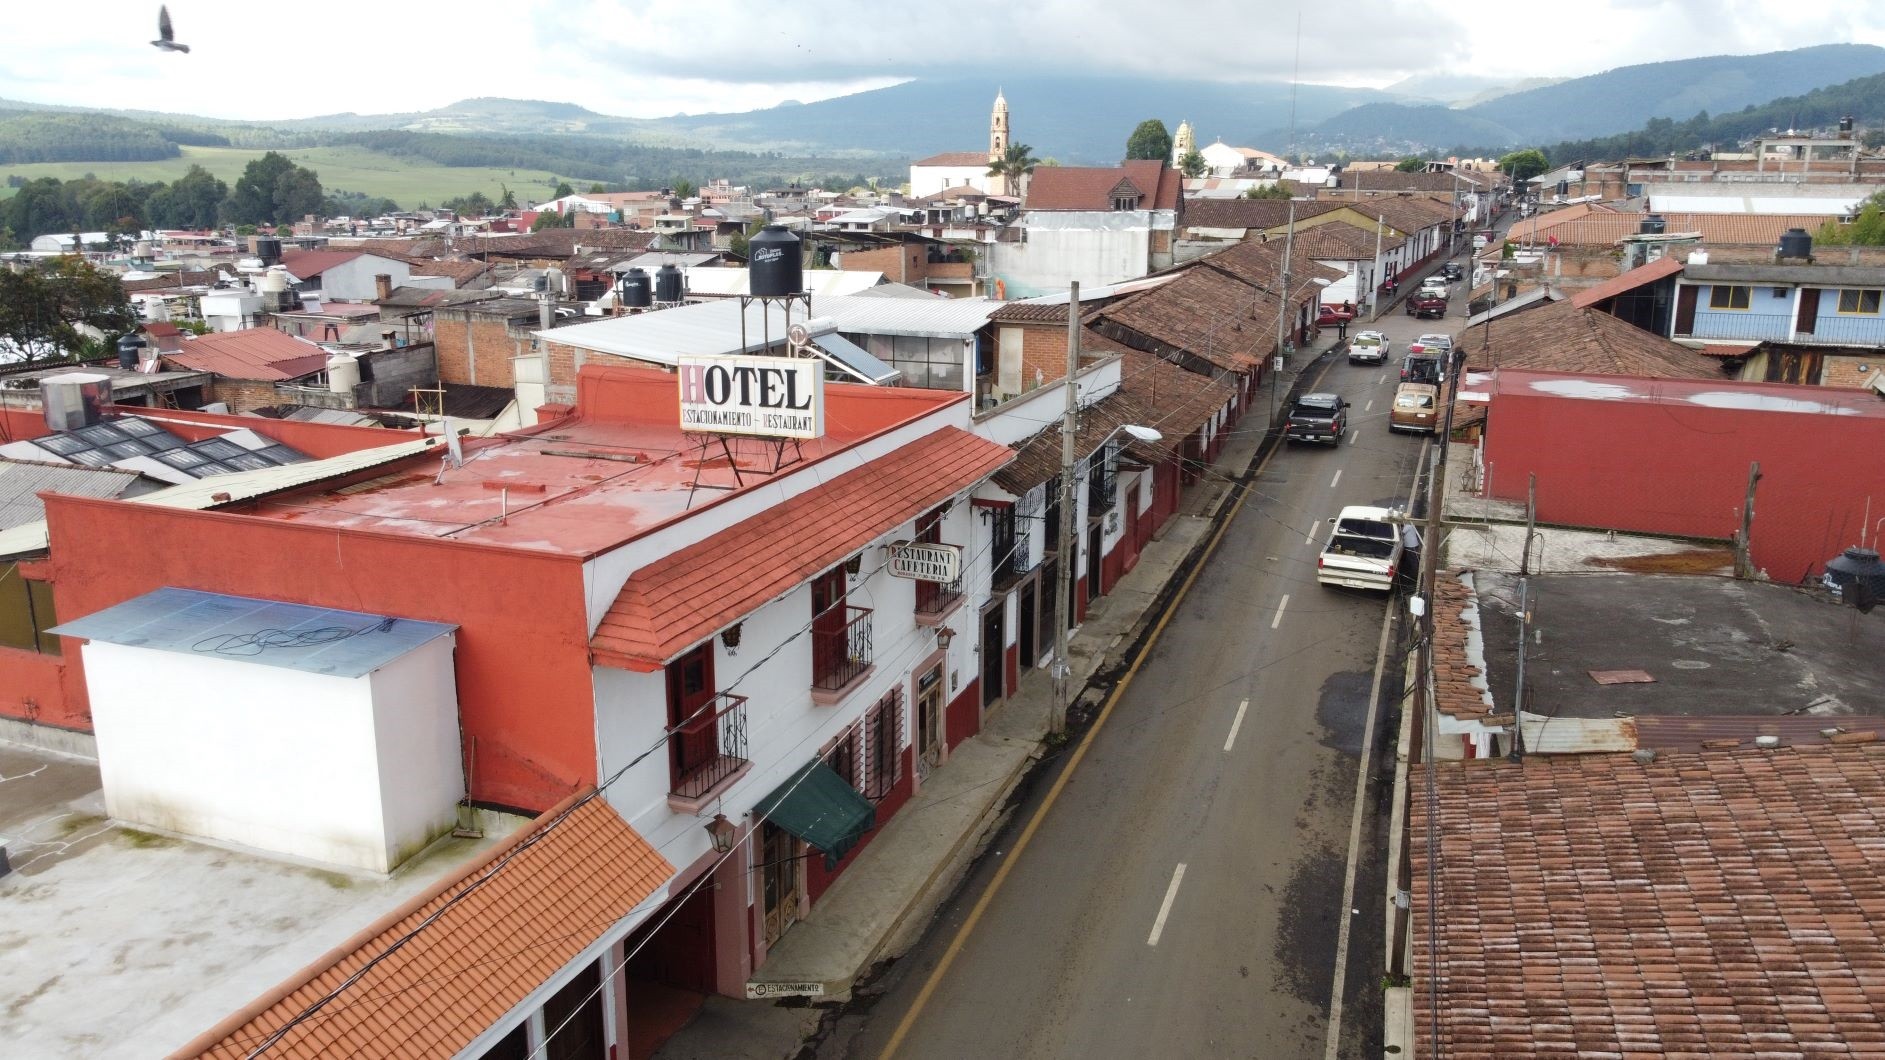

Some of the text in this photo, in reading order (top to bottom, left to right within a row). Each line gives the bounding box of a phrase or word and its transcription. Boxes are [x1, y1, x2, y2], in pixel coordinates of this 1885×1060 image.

[680, 365, 812, 410] HOTEL
[682, 409, 752, 427] ESTACIONAMIENTO
[763, 413, 812, 431] RESTAURANT
[891, 546, 951, 564] RESTAURANT
[894, 559, 948, 577] CAFETERIA
[767, 983, 819, 992] ESTACIONAMIENTO
